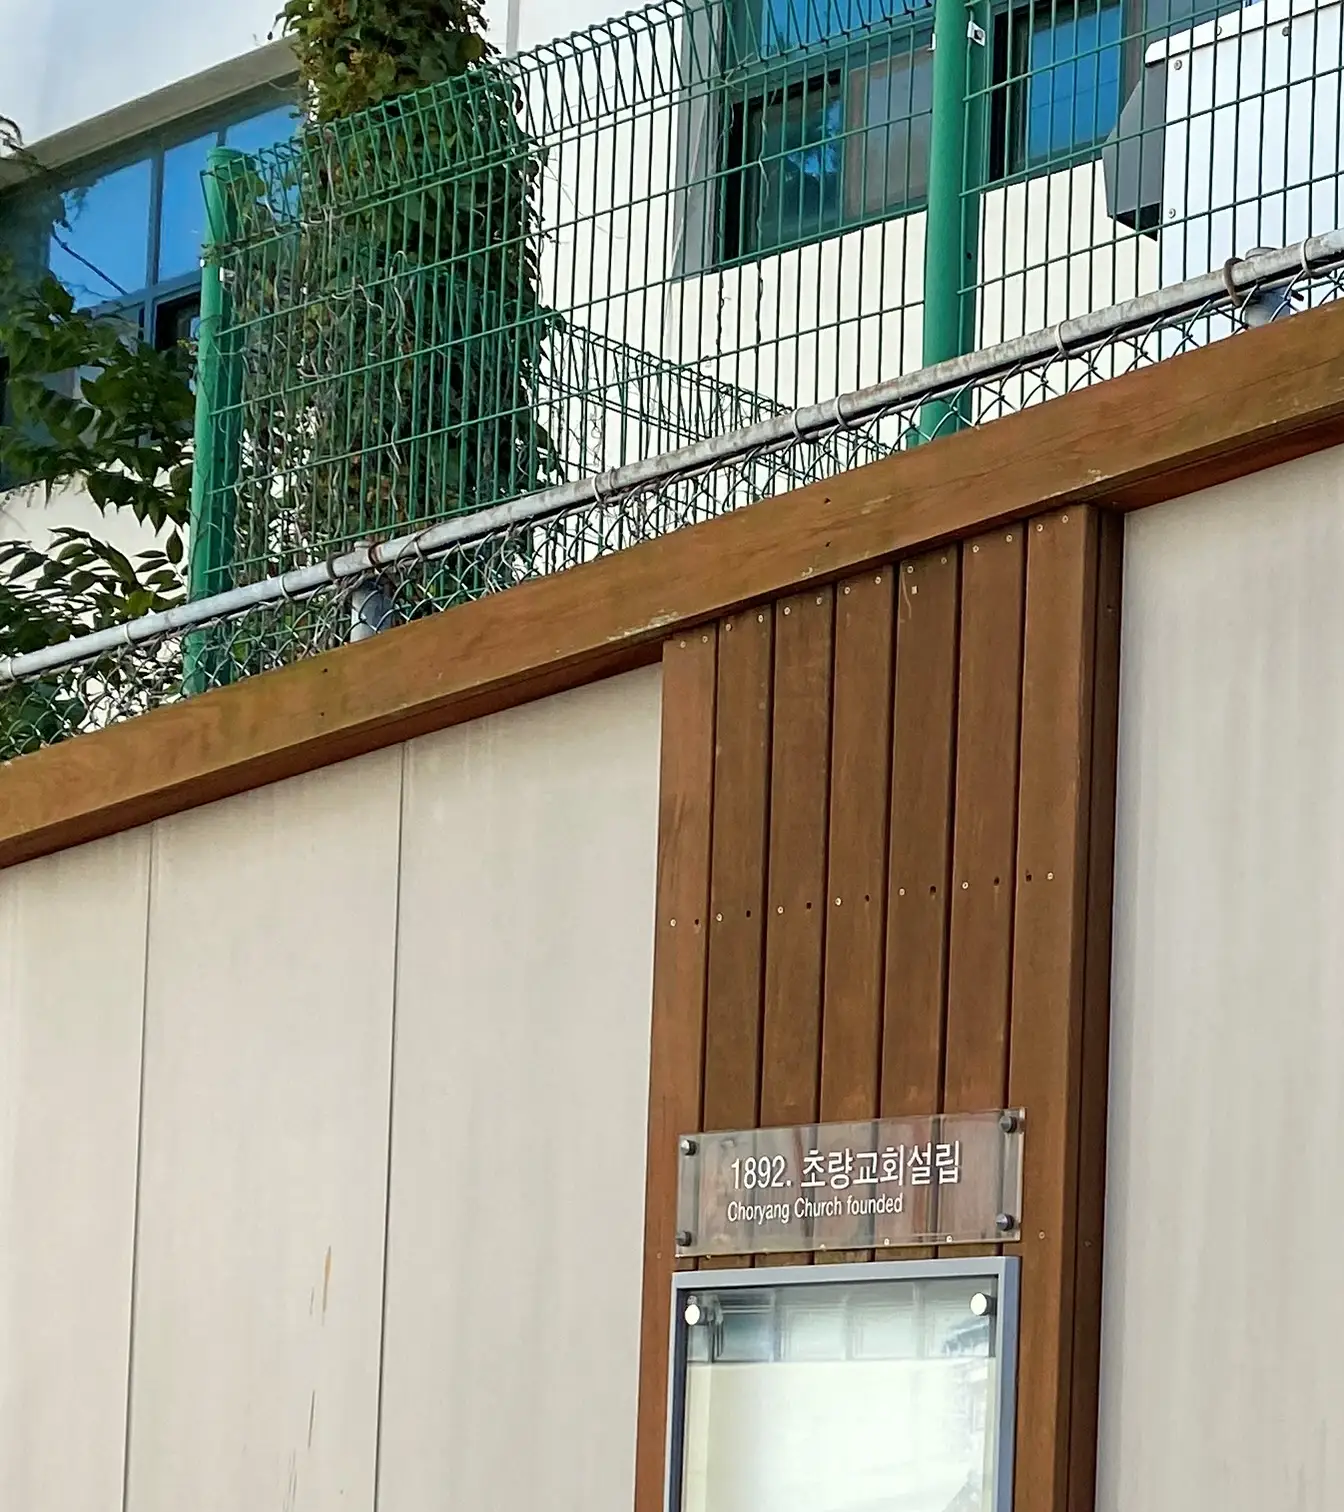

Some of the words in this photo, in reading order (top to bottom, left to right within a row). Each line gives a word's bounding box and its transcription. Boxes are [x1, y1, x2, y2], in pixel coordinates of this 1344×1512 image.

[731, 1155, 792, 1189] 1892.
[800, 1141, 960, 1189] 초량교회설립
[727, 1201, 790, 1225] Choryang
[794, 1197, 842, 1217] Church
[847, 1193, 903, 1215] founded
